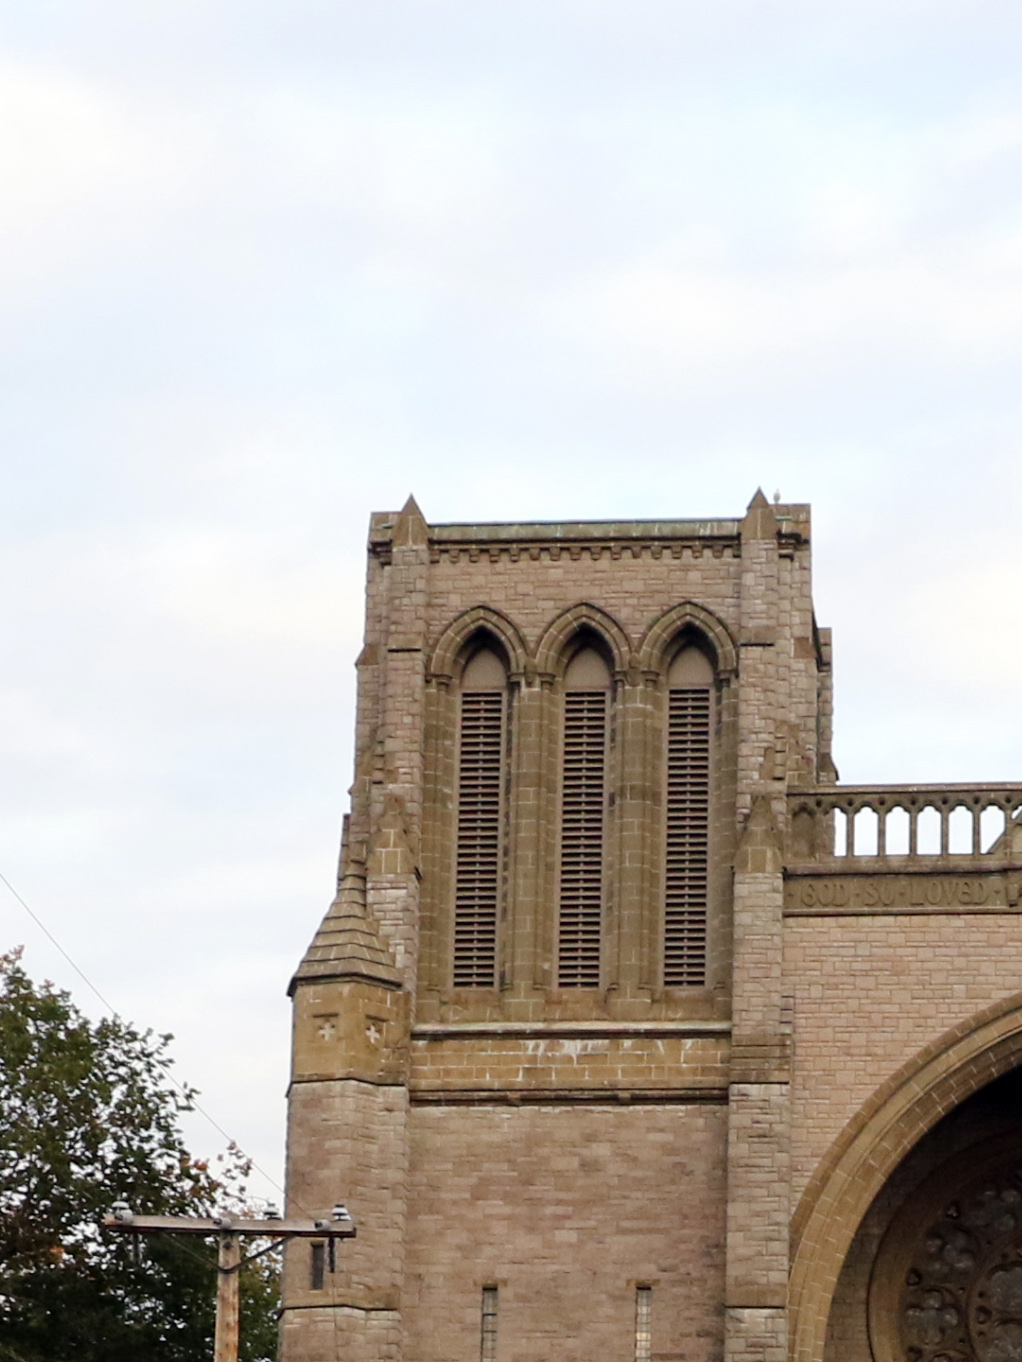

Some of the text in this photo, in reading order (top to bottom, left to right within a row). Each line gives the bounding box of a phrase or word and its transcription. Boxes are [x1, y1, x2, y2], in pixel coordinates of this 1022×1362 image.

[801, 883, 849, 907] GOD
[863, 882, 895, 906] SO
[909, 881, 989, 906] LOVED
